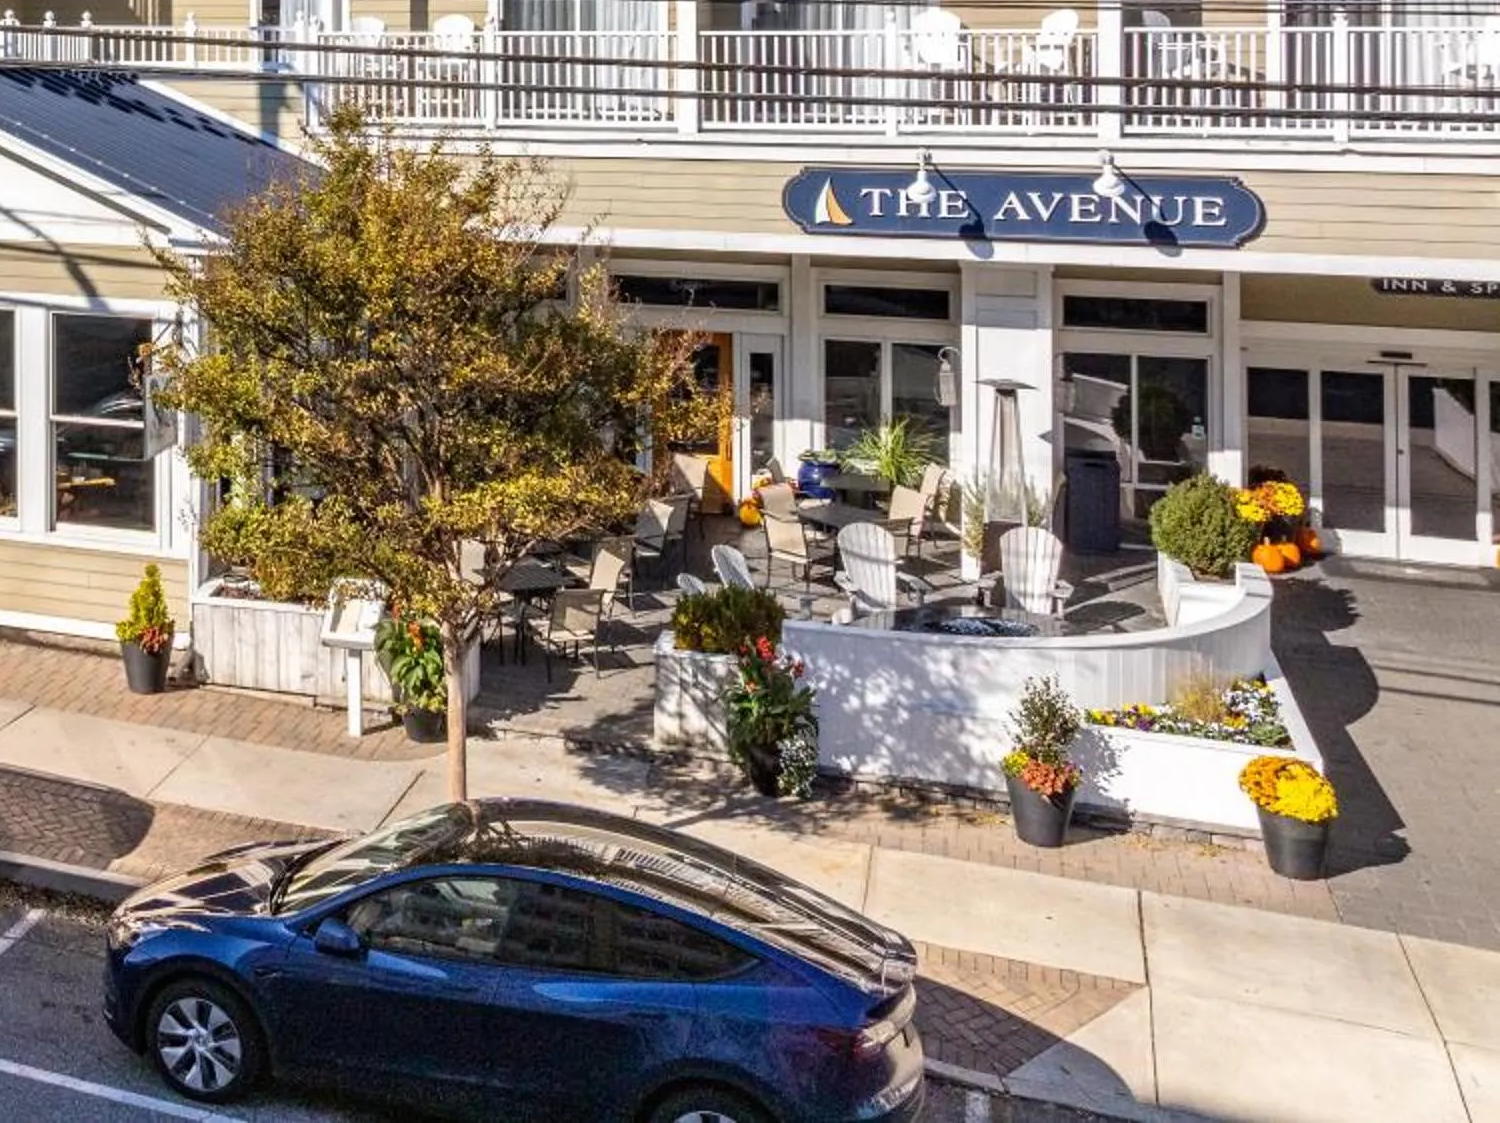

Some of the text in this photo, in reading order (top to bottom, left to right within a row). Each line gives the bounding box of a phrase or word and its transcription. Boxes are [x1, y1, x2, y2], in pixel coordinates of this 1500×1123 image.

[860, 188, 1228, 227] THE AVENUE
[1383, 278, 1428, 291] INN
[1441, 280, 1457, 293] &
